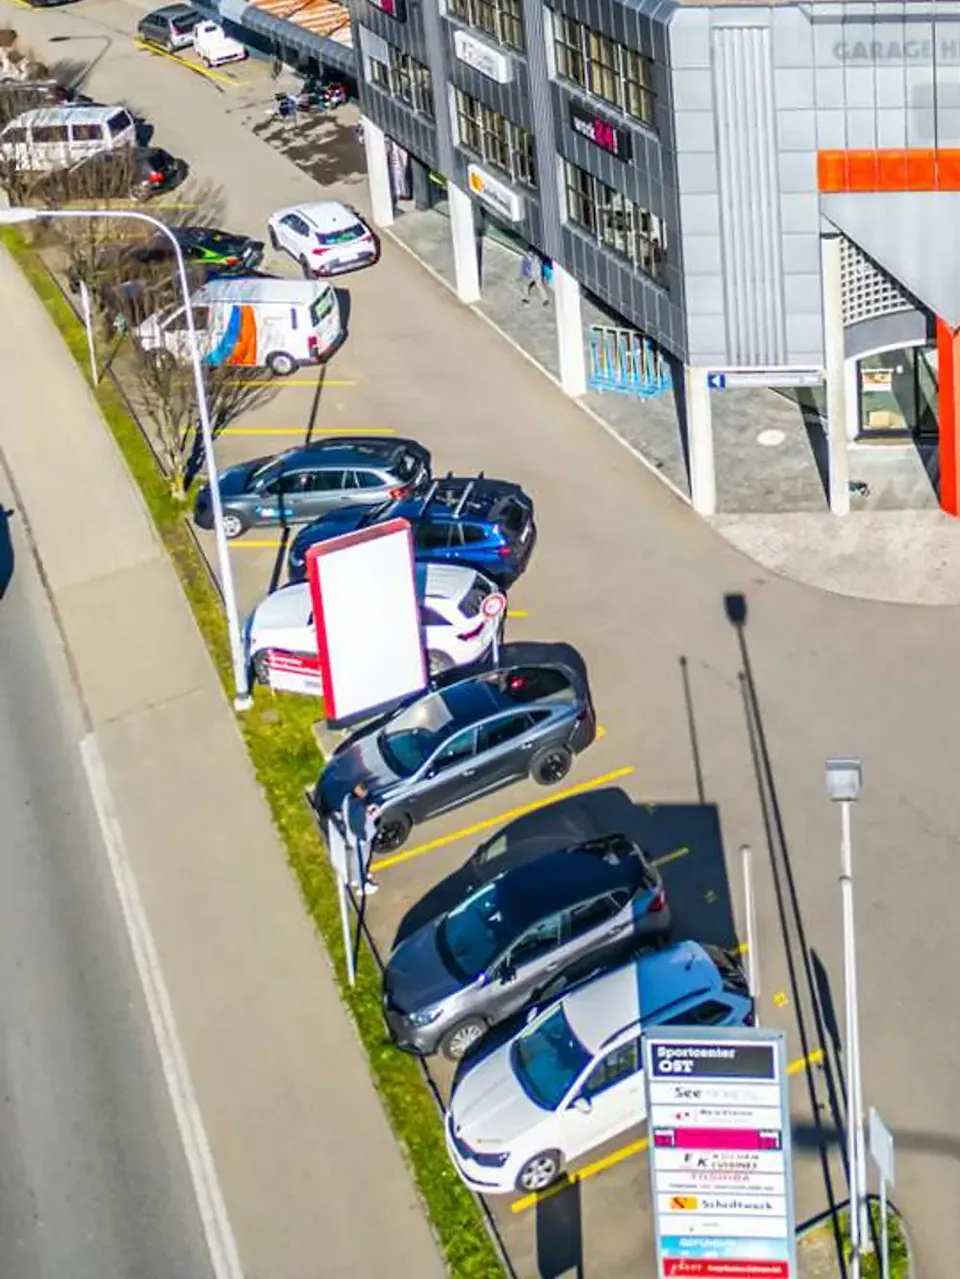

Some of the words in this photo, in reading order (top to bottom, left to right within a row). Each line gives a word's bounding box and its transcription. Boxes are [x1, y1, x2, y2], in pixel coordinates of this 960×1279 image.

[832, 40, 933, 60] GARAGE
[657, 1046, 735, 1059] Sportcenter
[659, 1060, 693, 1072] OST
